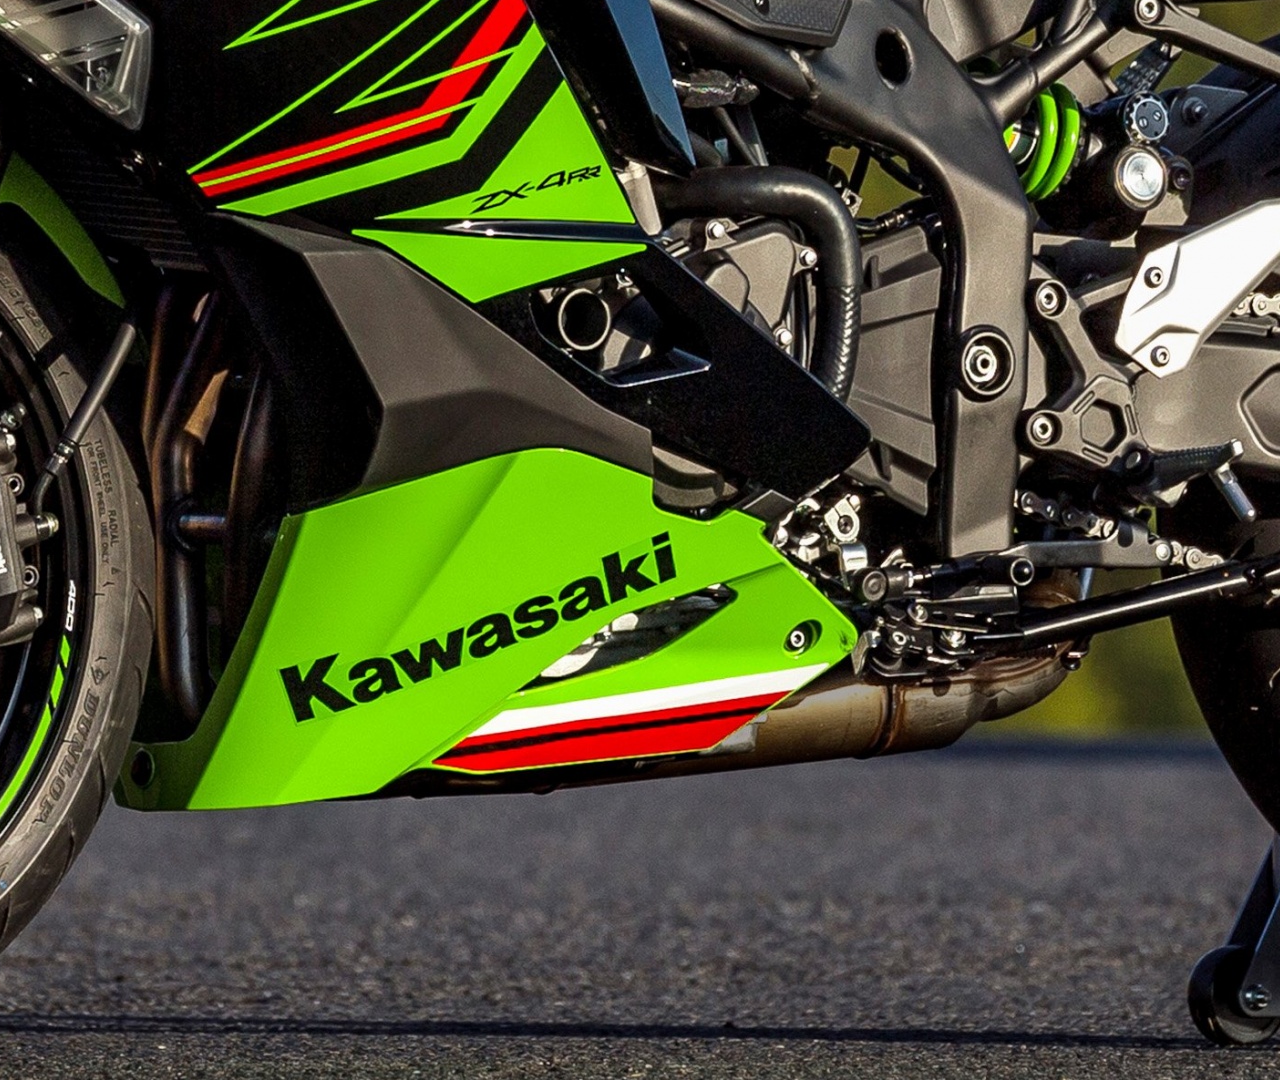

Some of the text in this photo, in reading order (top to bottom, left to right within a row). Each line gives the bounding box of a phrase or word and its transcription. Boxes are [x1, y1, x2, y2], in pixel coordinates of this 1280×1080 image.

[107, 509, 120, 547] RADIAL
[65, 579, 77, 632] 400
[279, 531, 677, 723] Kawasaki
